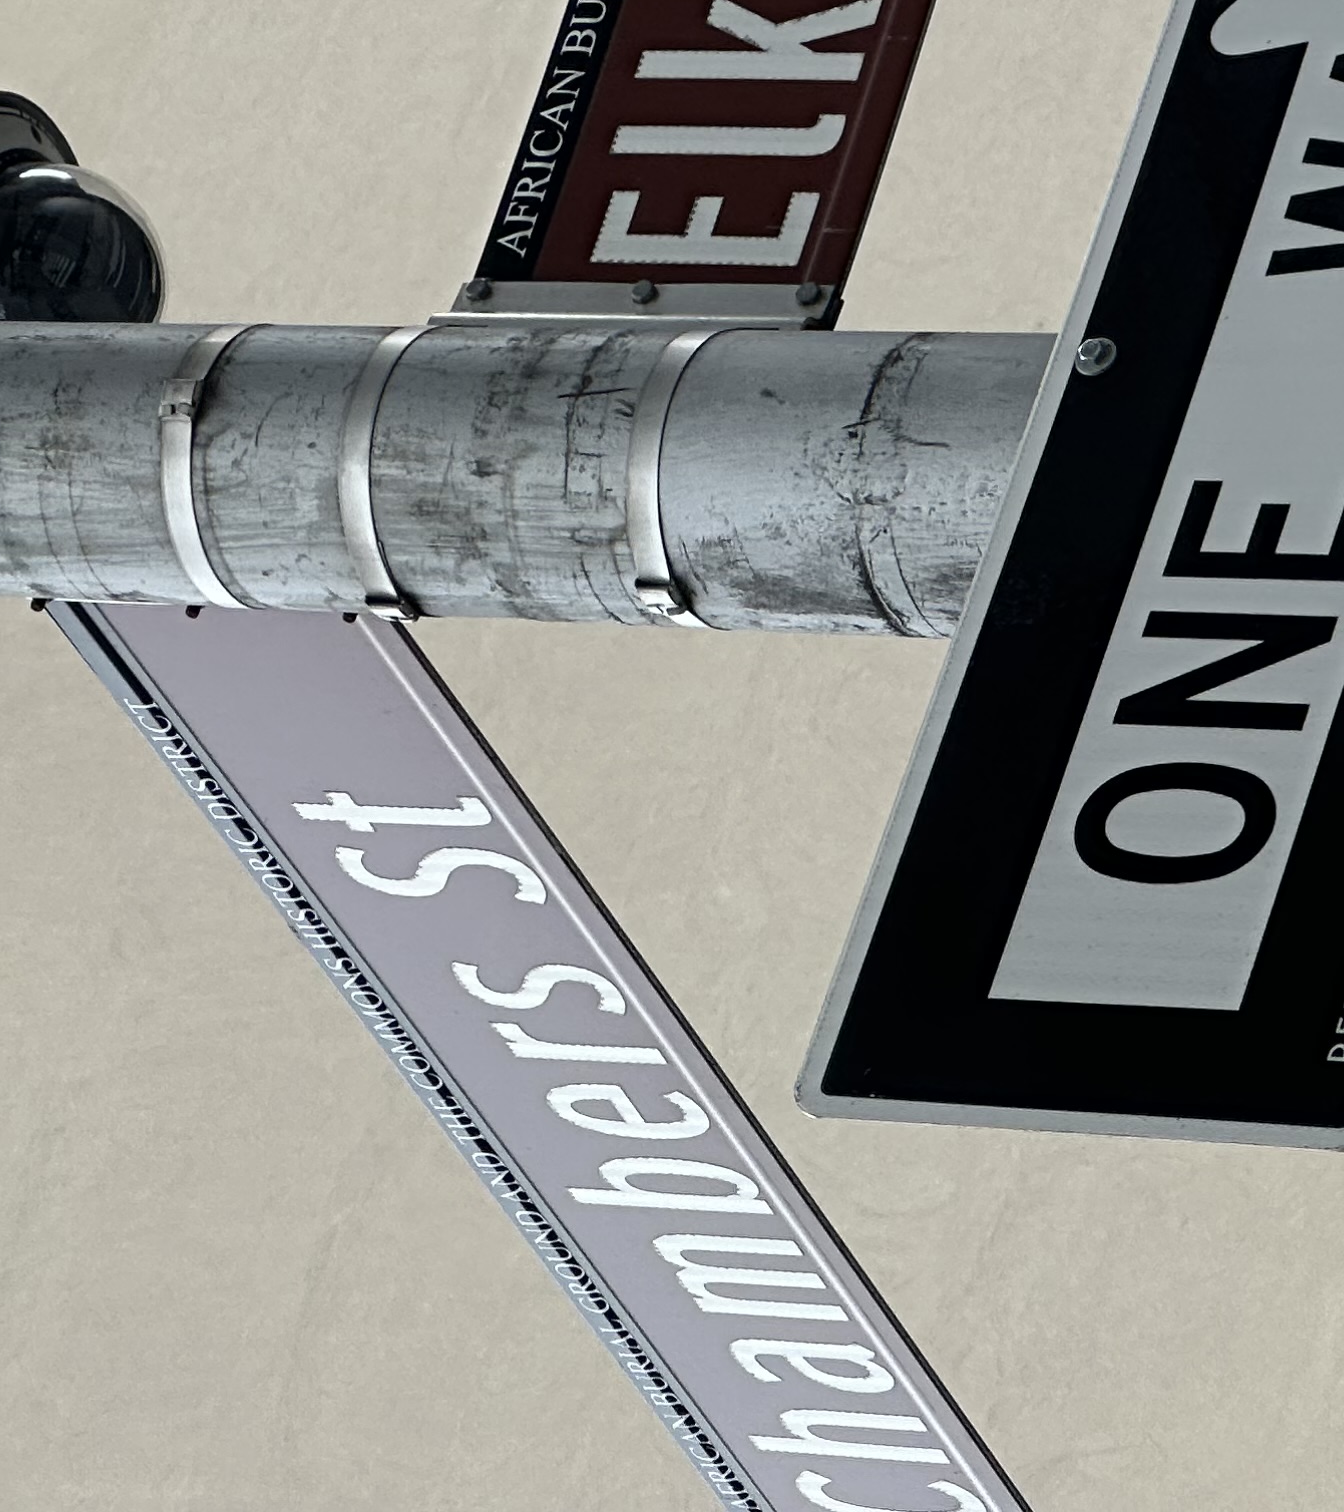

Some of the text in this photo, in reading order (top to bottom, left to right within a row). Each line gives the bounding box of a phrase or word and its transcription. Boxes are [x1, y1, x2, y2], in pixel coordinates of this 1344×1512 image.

[497, 66, 586, 258] AFRICAN
[291, 790, 547, 906] St
[123, 697, 760, 1510] AFRICAN BURIAL GROUND AND THE COMMONS HISTORIC DISTRICT
